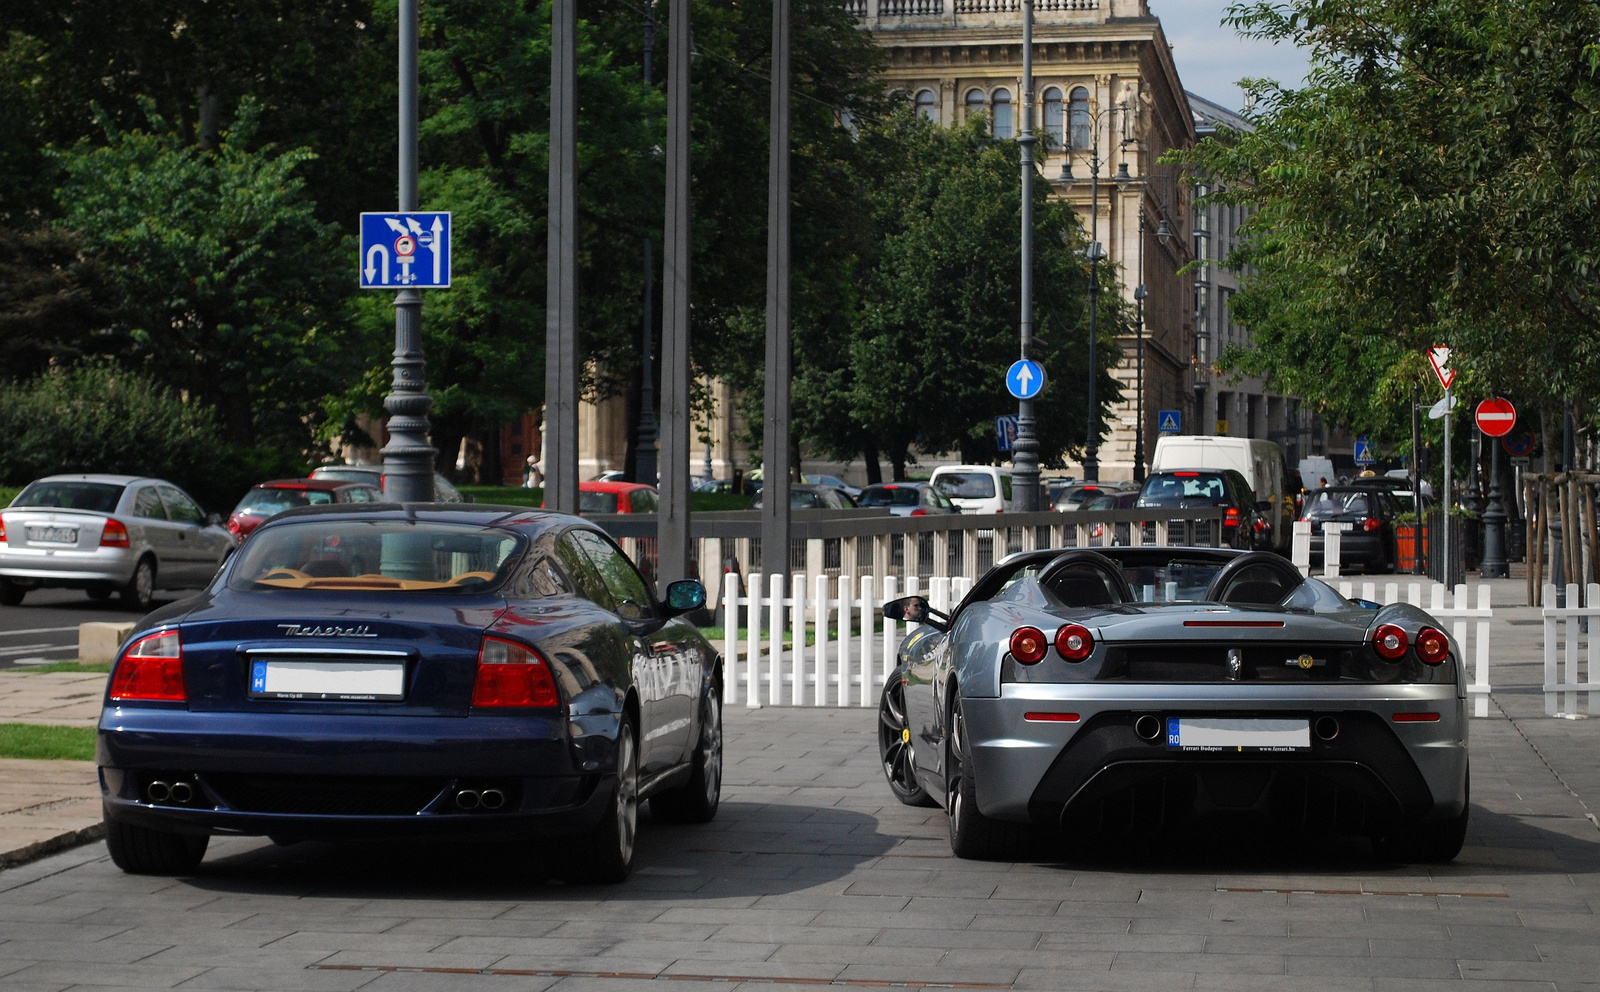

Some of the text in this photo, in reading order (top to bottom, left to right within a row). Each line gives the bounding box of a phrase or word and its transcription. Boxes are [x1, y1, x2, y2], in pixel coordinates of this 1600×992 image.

[277, 624, 378, 637] Maserati
[254, 678, 263, 688] H
[1169, 734, 1180, 744] RO
